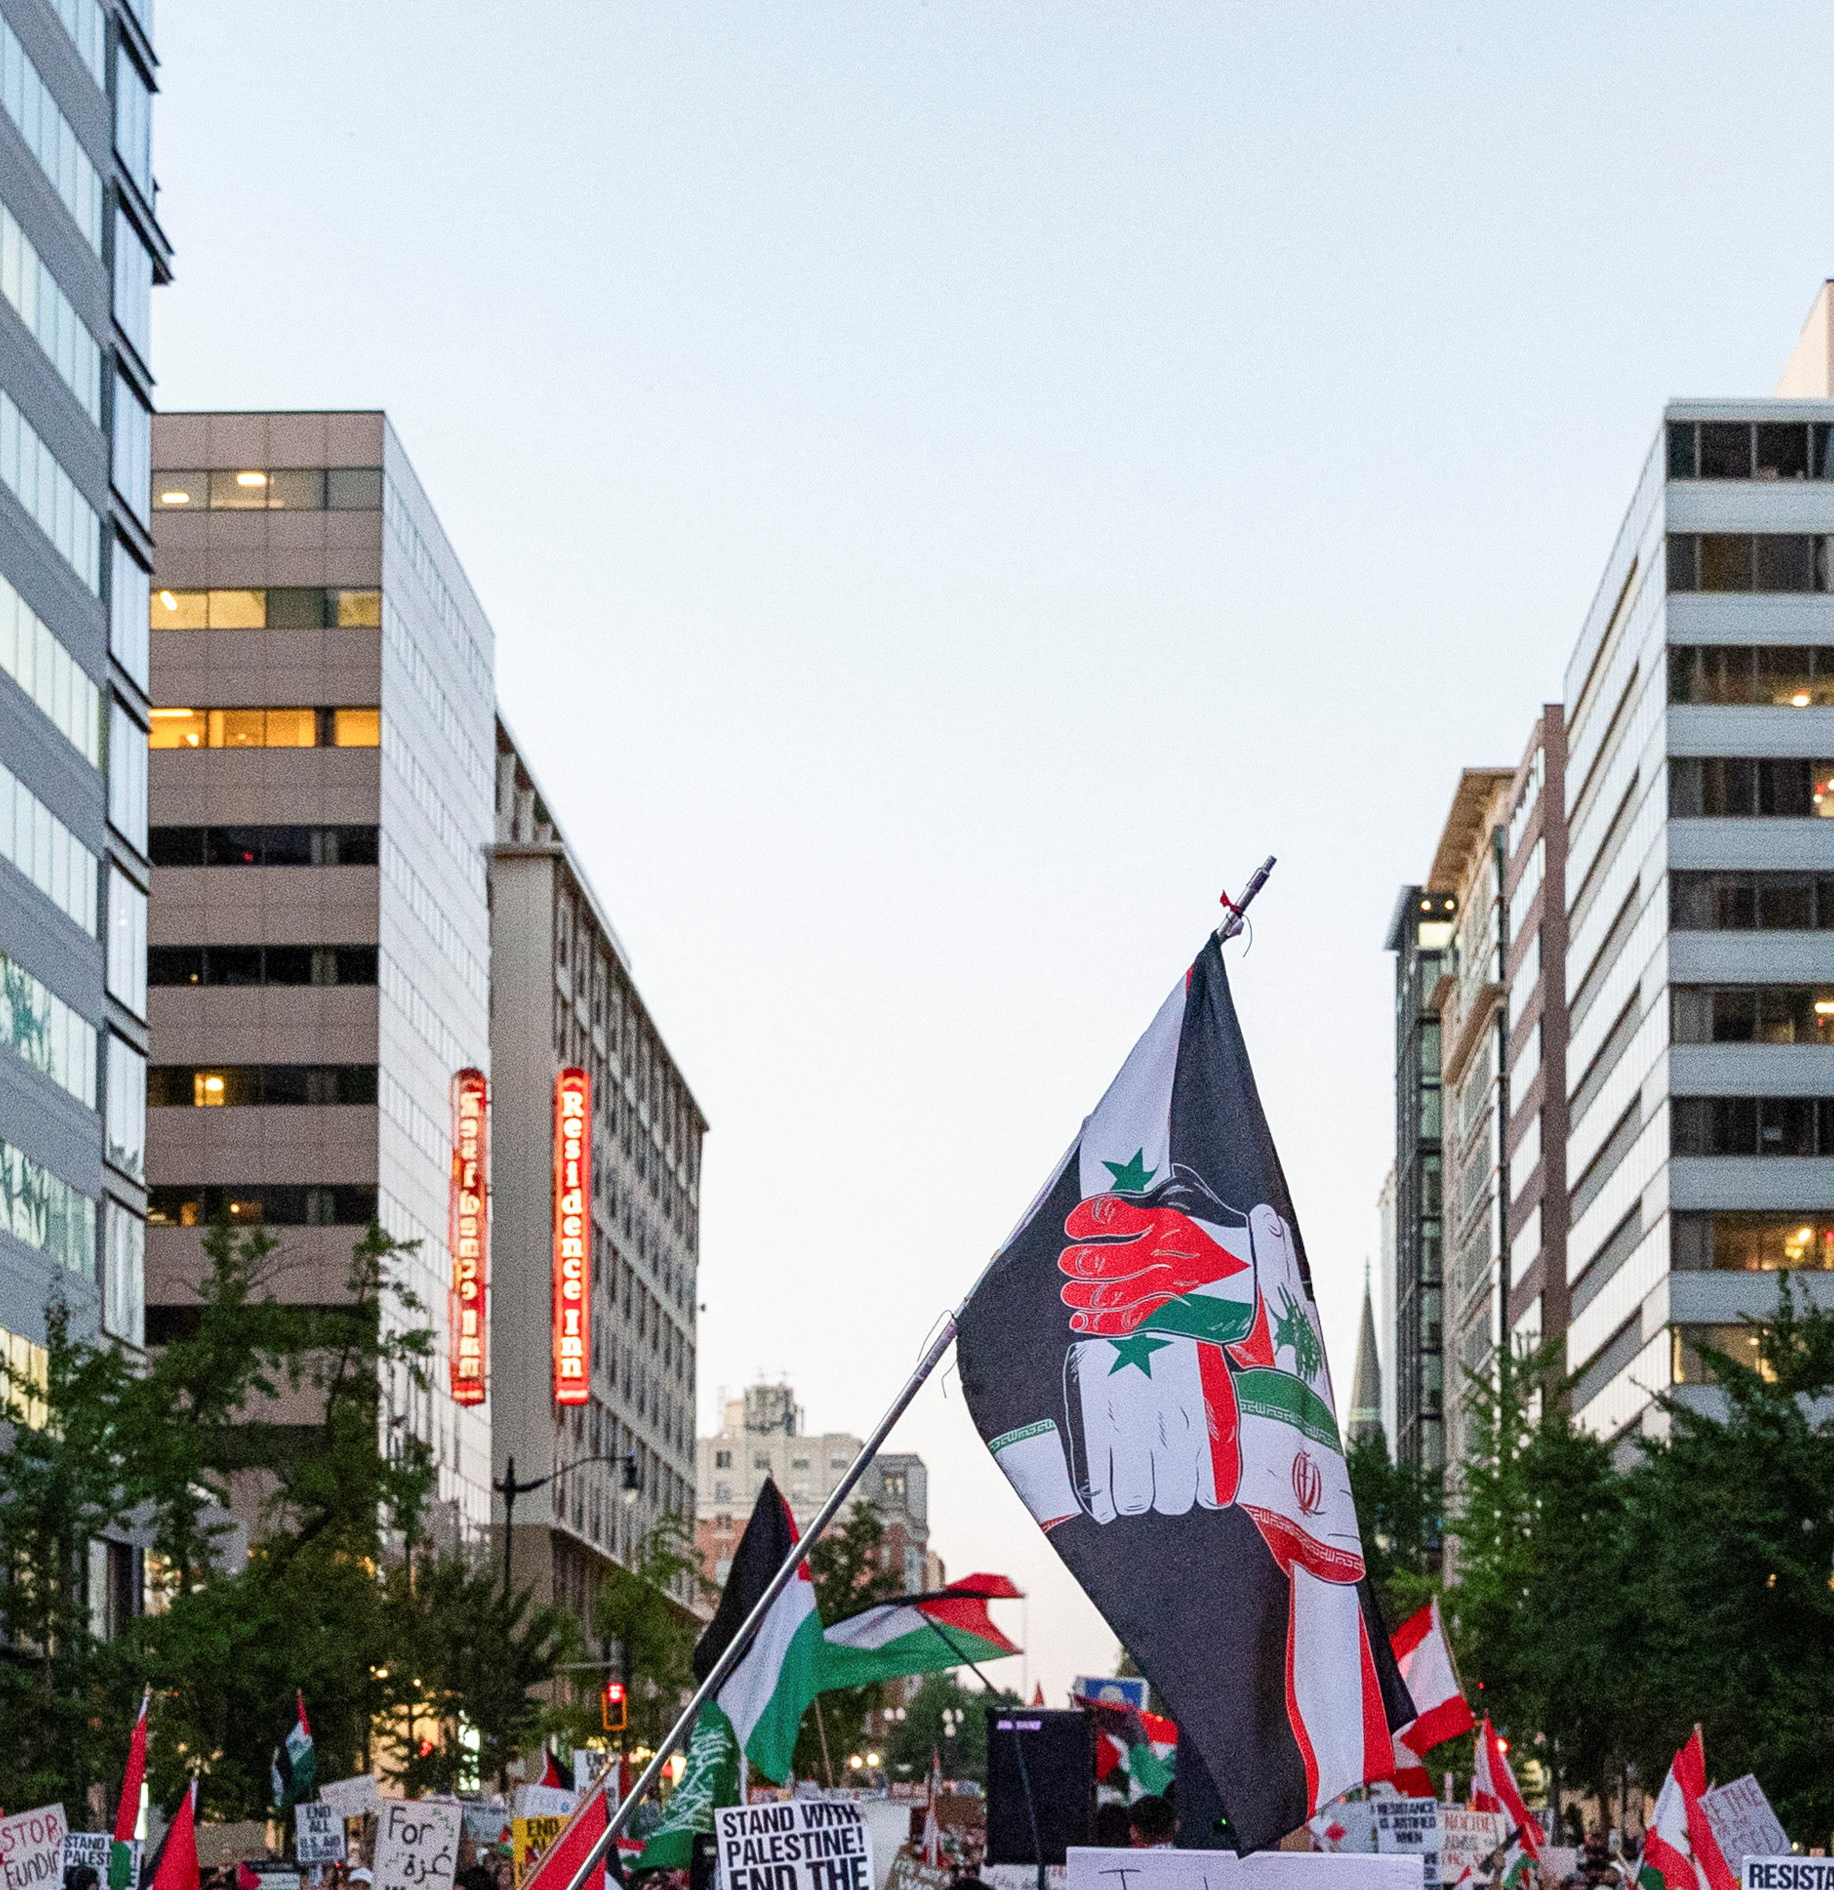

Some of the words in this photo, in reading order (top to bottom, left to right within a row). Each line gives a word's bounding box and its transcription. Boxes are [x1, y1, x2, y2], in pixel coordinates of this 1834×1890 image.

[562, 1091, 584, 1300] Residence
[560, 1309, 584, 1378] Inn
[306, 1805, 331, 1820] END
[308, 1821, 330, 1834] ALL
[388, 1805, 435, 1845] For
[723, 1806, 794, 1838] STAND
[801, 1803, 861, 1829] WITH
[64, 1836, 106, 1850] STAND
[726, 1827, 865, 1868] PALESTINE!
[403, 1845, 453, 1884] غزة
